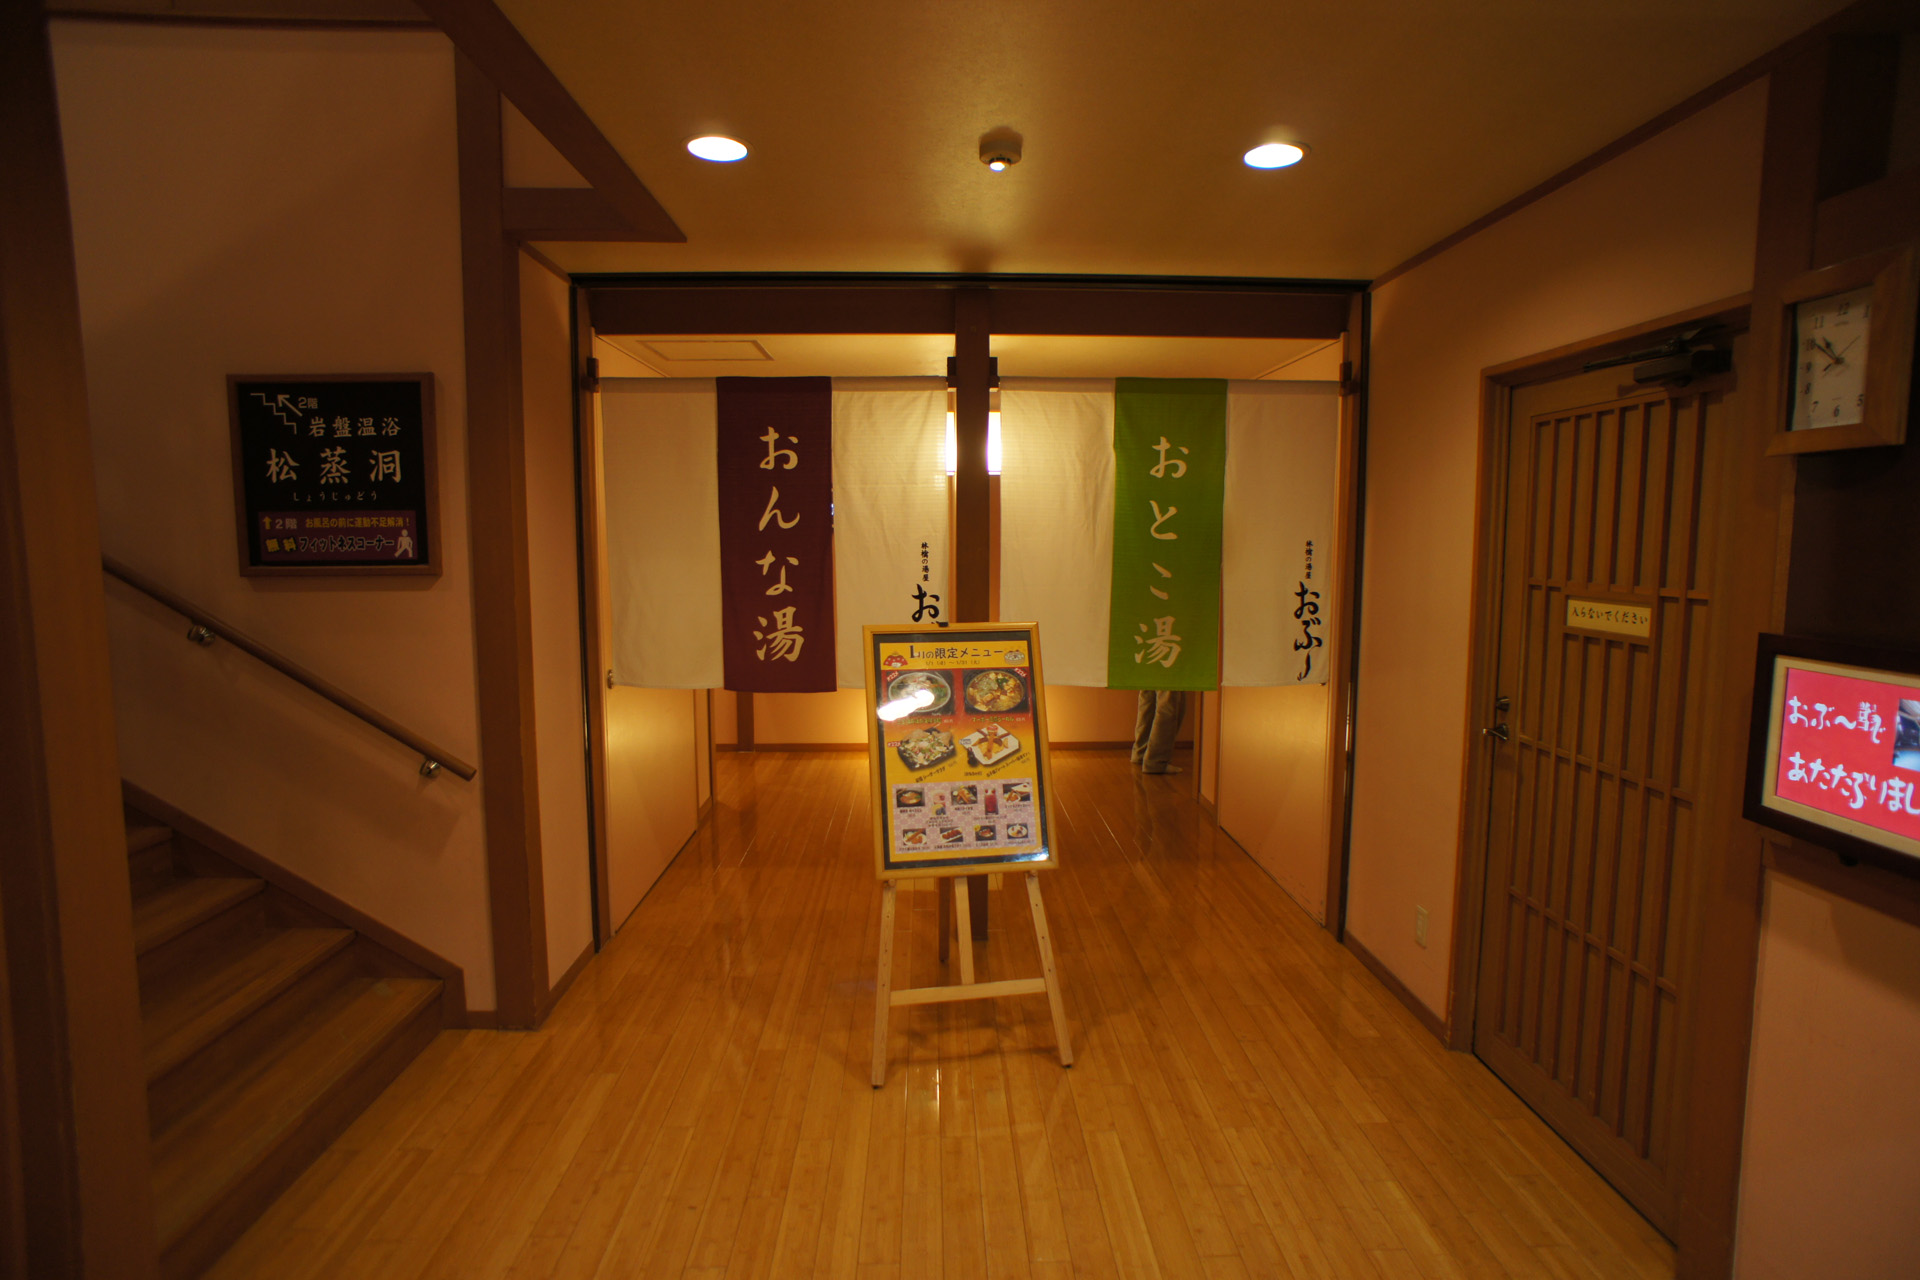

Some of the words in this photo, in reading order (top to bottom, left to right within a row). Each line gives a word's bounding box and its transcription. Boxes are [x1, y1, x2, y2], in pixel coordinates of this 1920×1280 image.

[1836, 301, 1851, 316] 12
[1814, 316, 1825, 329] 11
[297, 396, 319, 409] 2階
[307, 415, 402, 438] 岩盤温浴
[265, 445, 403, 485] 松蒸洞
[292, 490, 378, 503] しょうじゅどう
[298, 534, 396, 554] フィットネスコーナー
[752, 425, 805, 663] おんな湯
[1133, 435, 1190, 669] おとこ湯
[1571, 605, 1649, 626] 入らないでください
